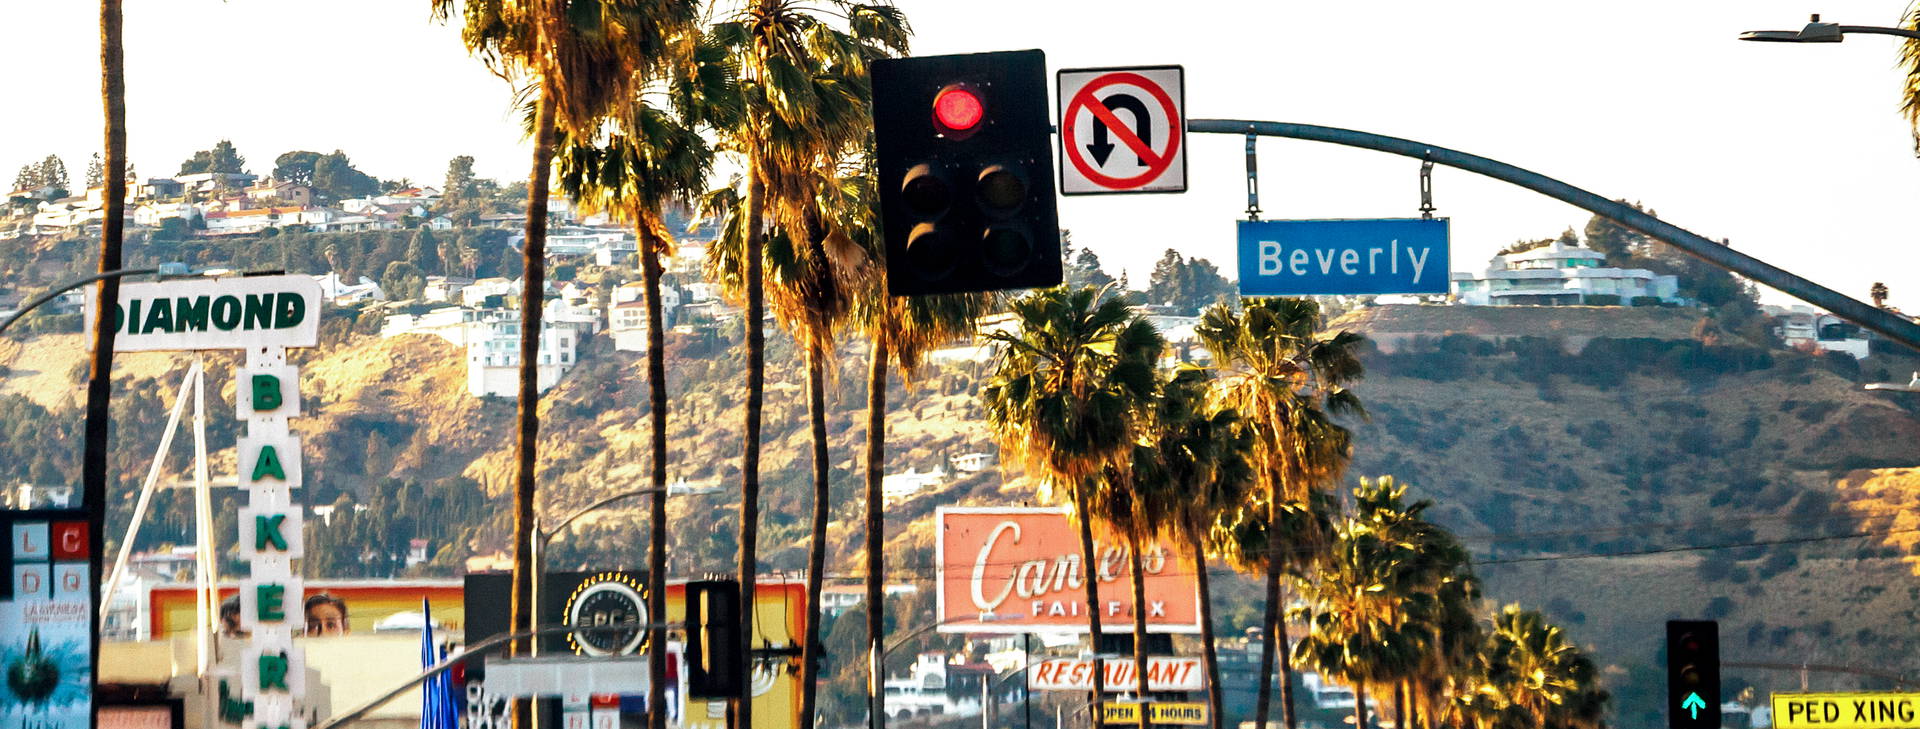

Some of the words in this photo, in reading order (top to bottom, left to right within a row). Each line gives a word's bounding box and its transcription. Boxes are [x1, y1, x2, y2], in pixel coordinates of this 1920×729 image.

[1258, 239, 1430, 284] Beverly
[62, 528, 81, 553] C
[251, 373, 291, 729] BAKER
[1032, 600, 1167, 617] FAIFX
[1160, 707, 1202, 721] HOURS
[1788, 701, 1840, 723] PED
[1853, 700, 1915, 723] XING
